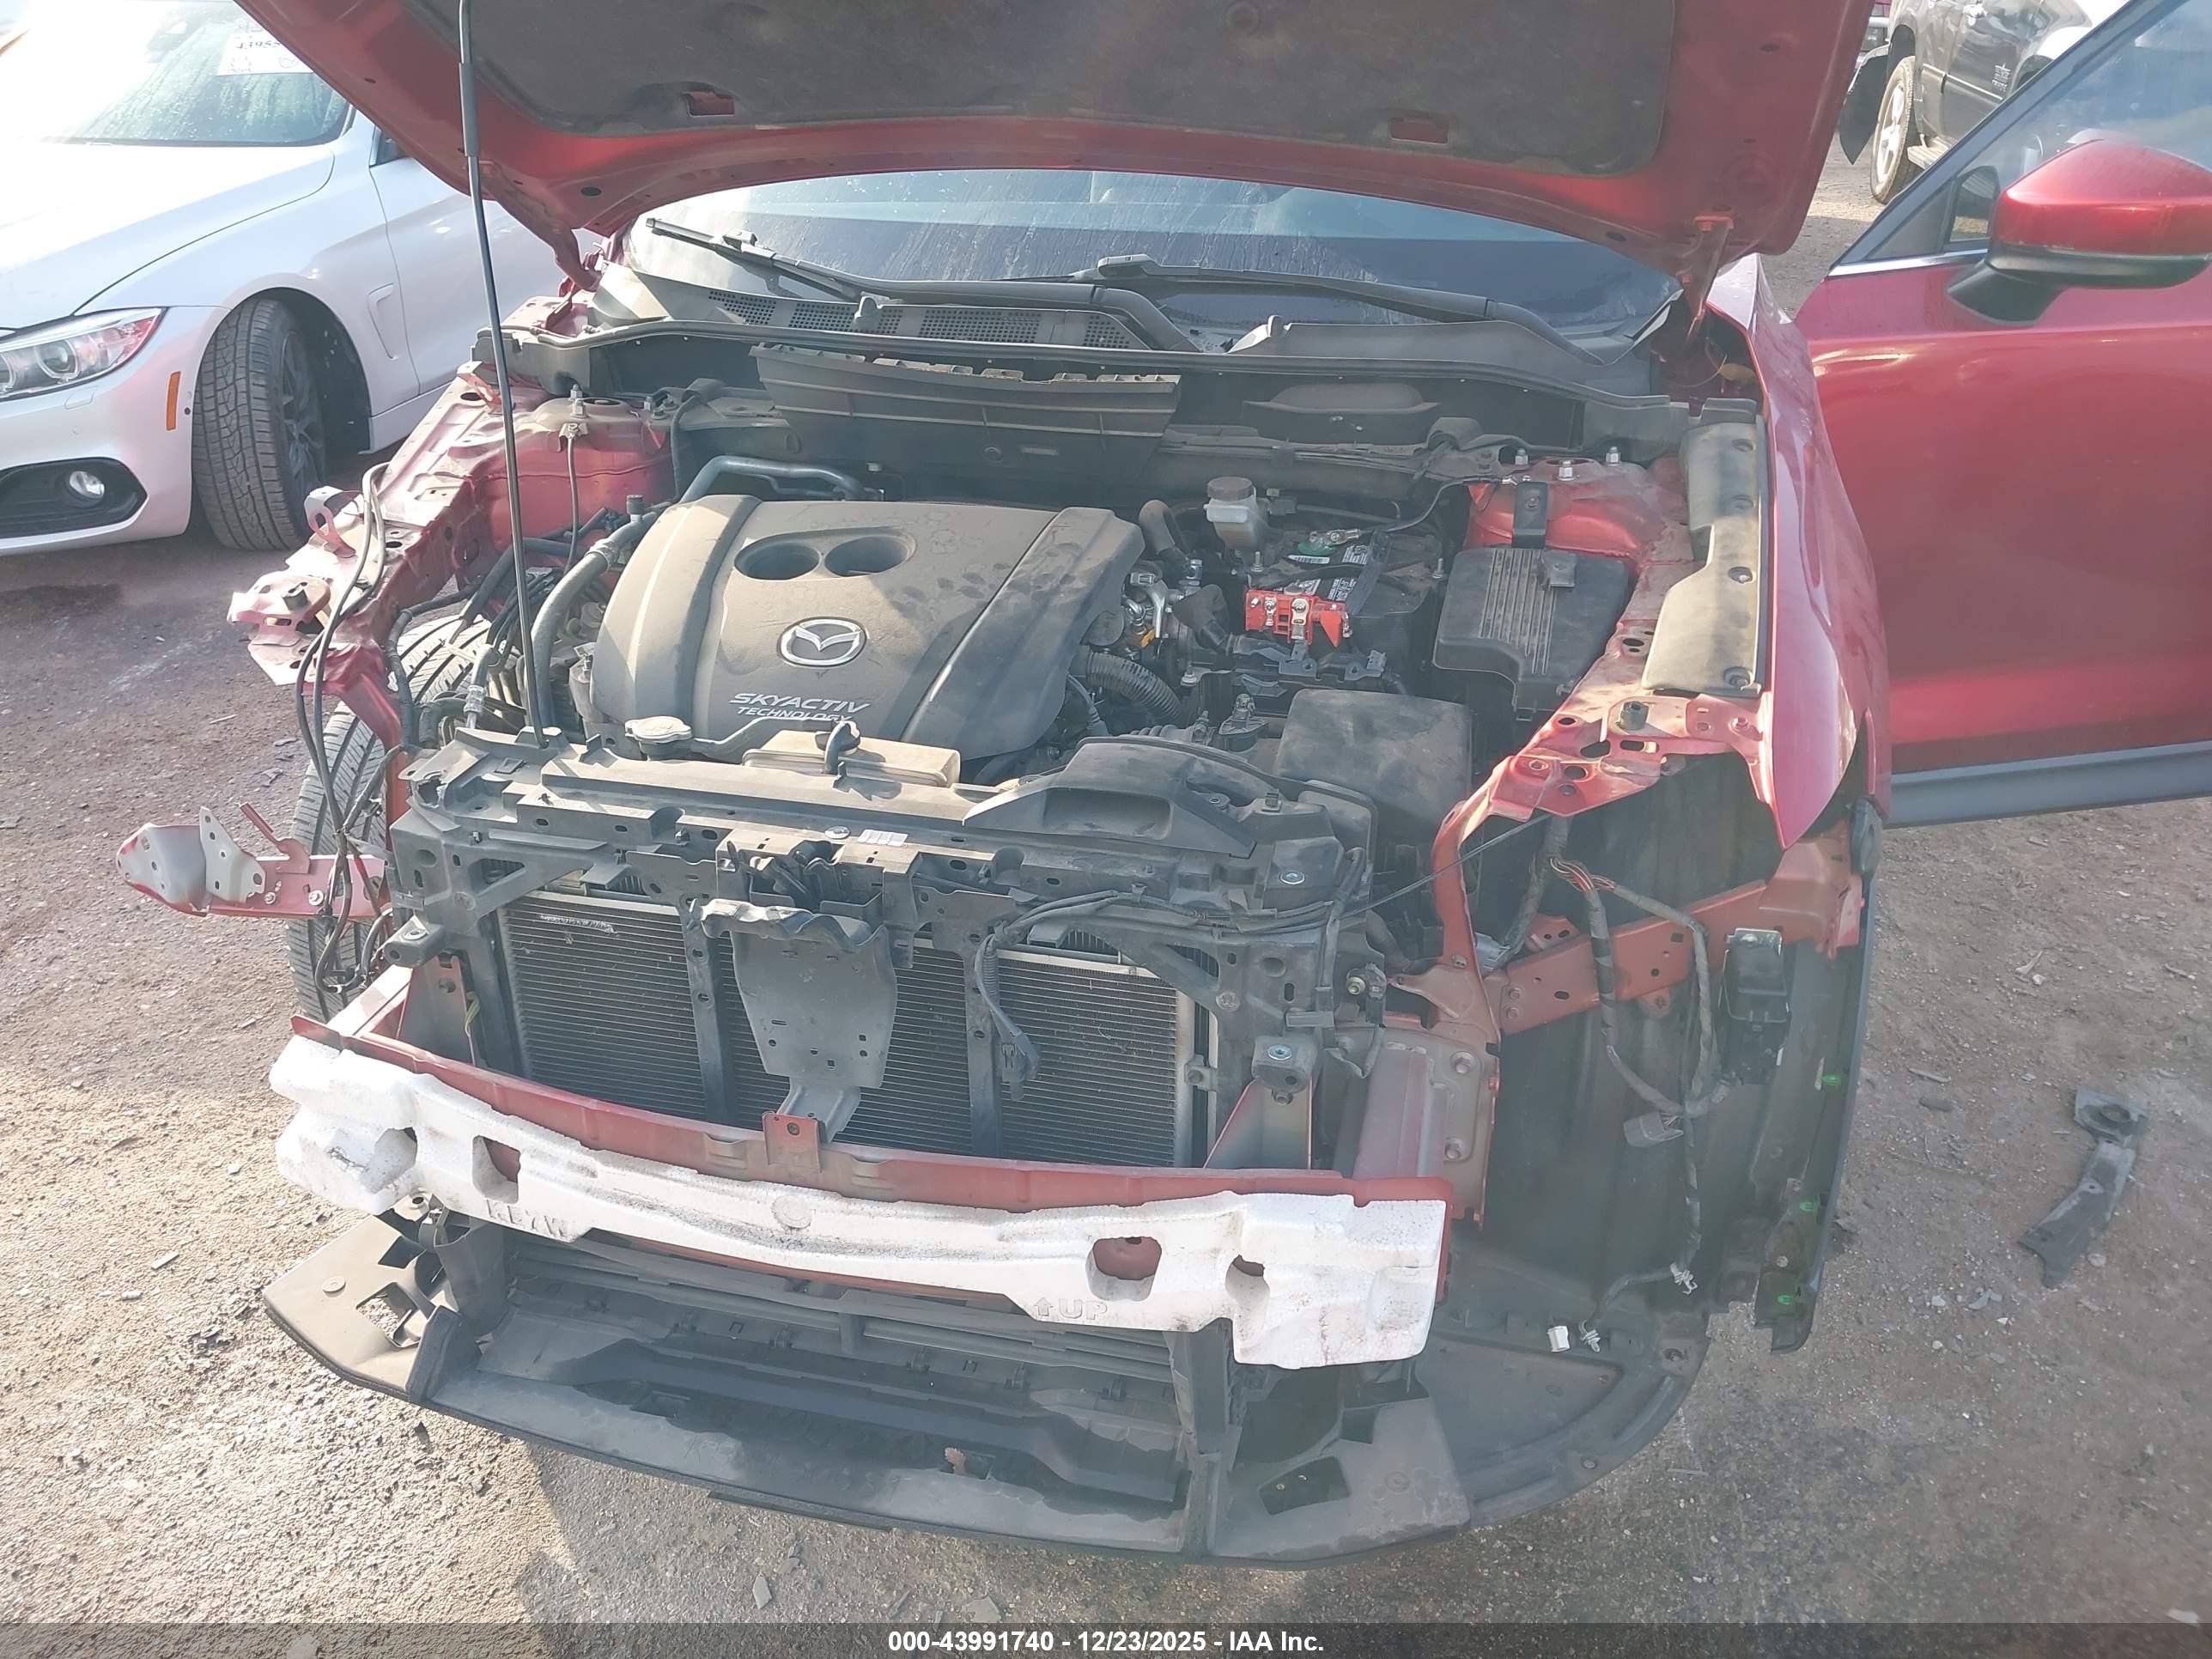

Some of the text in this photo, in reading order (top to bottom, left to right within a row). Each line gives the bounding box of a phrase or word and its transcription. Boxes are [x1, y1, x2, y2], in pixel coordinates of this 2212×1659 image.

[729, 692, 871, 714] SKYACTIV
[737, 706, 852, 724] TECHNOLOGY
[1059, 1298, 1108, 1320] UP
